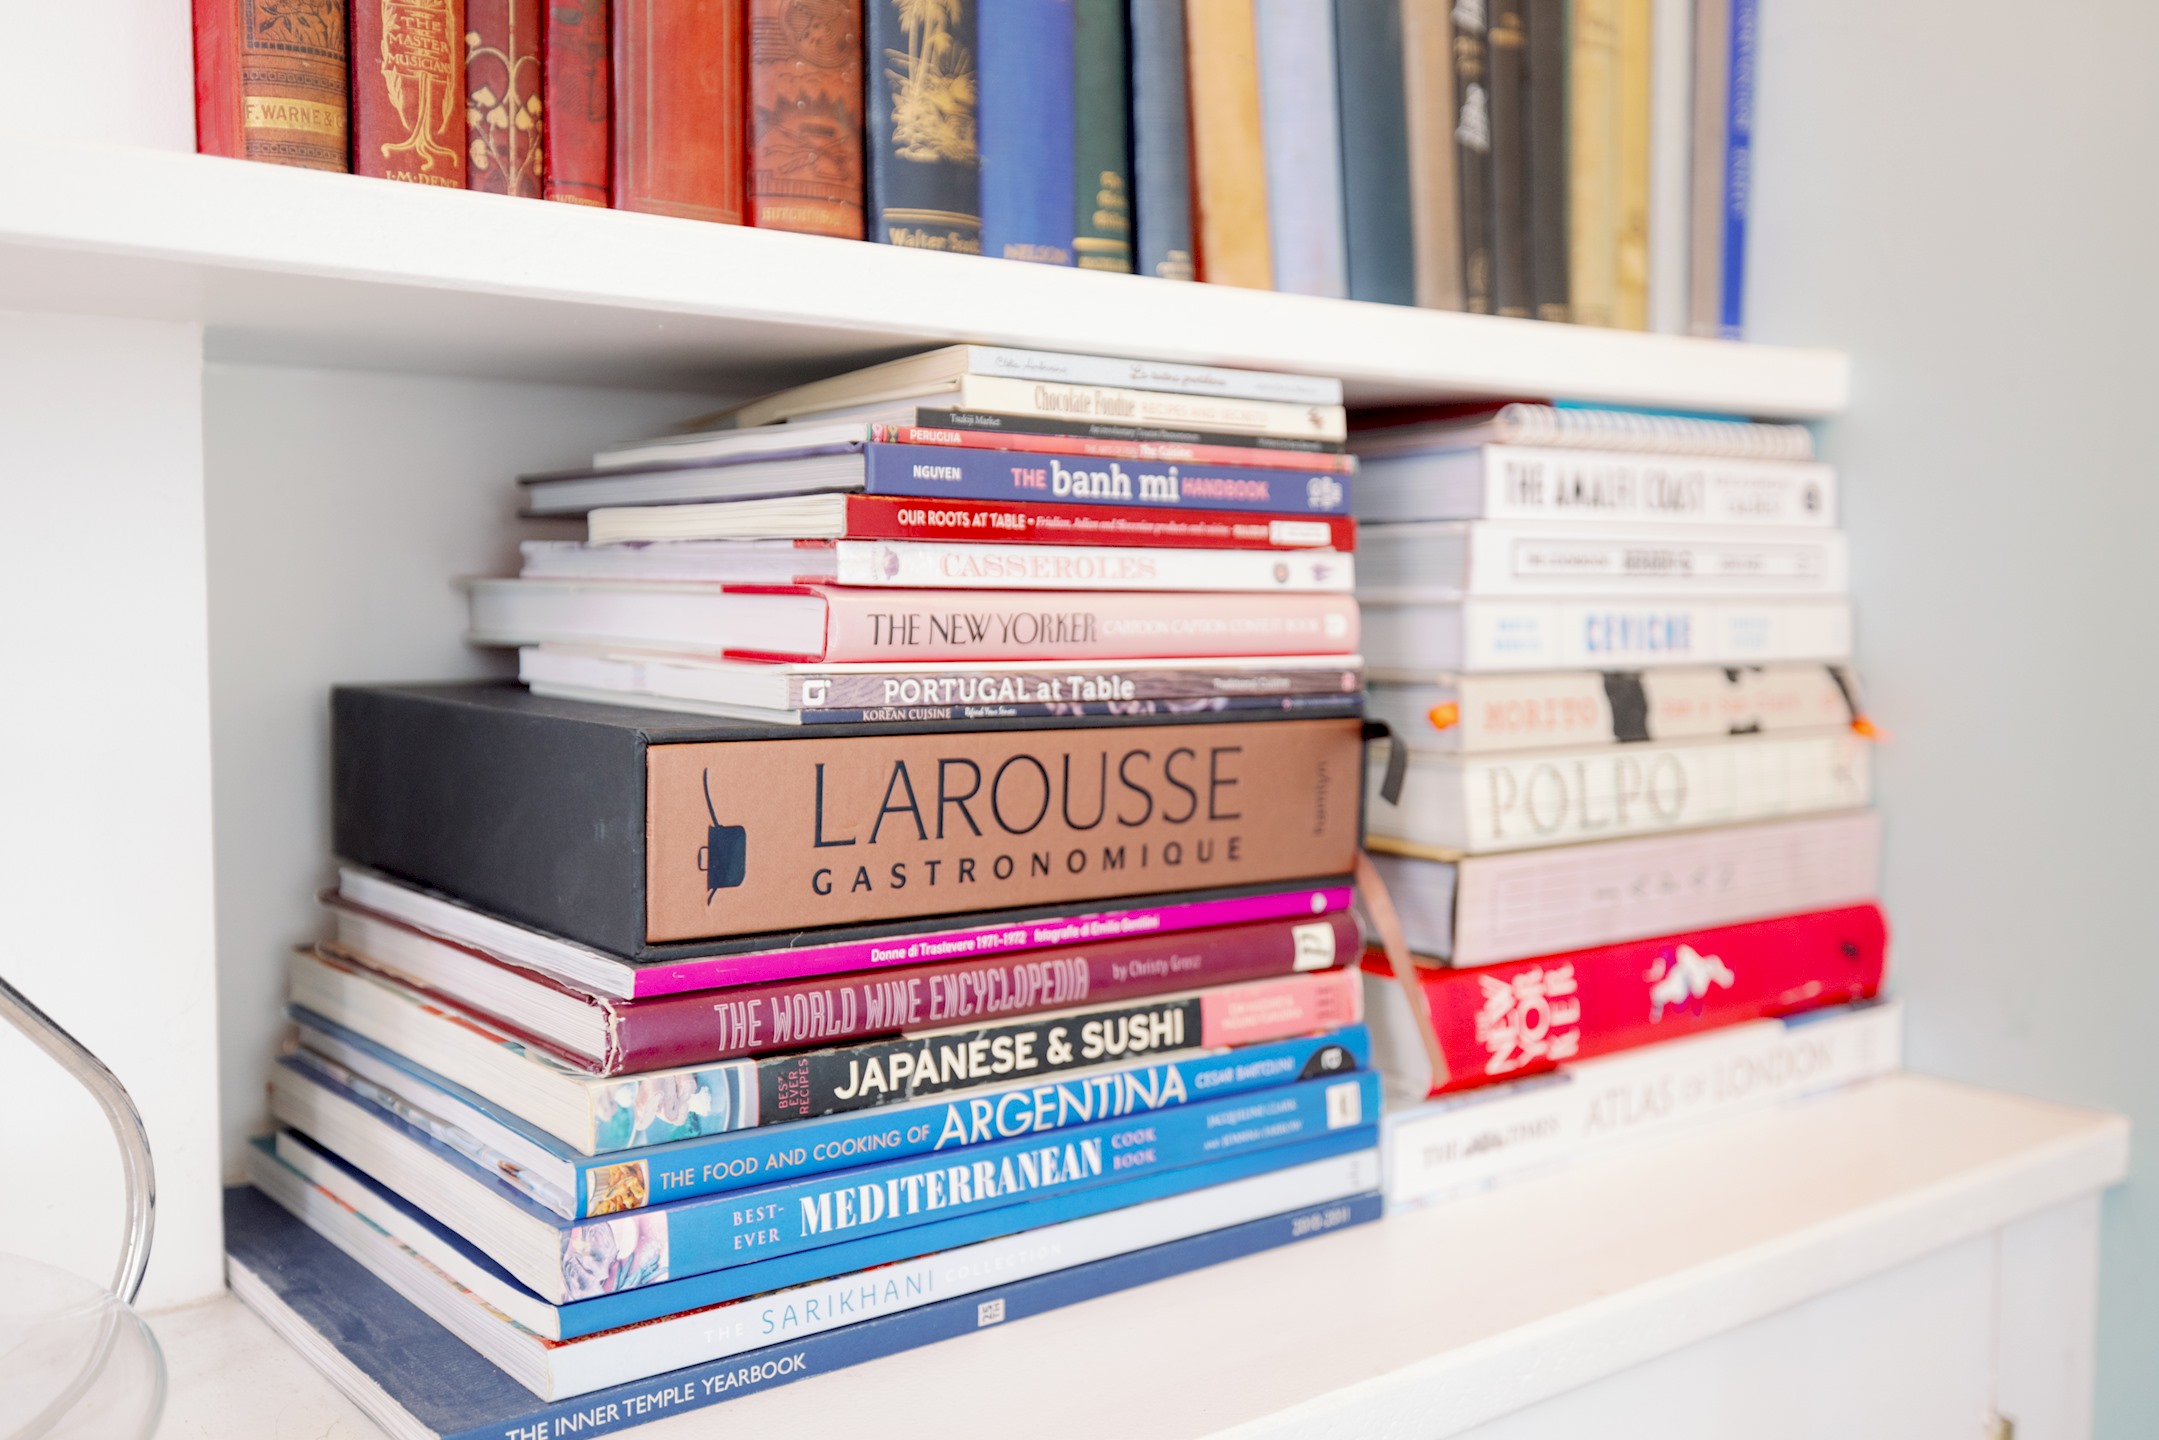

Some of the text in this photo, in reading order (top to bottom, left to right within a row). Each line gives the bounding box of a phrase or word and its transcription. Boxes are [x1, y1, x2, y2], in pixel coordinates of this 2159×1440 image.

[387, 32, 450, 53] MASTER
[401, 16, 441, 31] THE
[387, 53, 452, 73] MUSICIANS
[888, 227, 947, 250] Walter
[950, 413, 1001, 427] Tsukiji Market
[1034, 385, 1092, 414] Chocolate
[1094, 391, 1135, 417] Fondue
[913, 460, 1271, 502] NGUYEN THE banh mi HANDBOOK
[1505, 460, 1545, 507] THE
[897, 508, 926, 527] OUR
[927, 510, 970, 528] ROOTS
[972, 511, 989, 528] AT
[989, 512, 1027, 530] TABLE
[938, 552, 1157, 579] CASSEROLES
[866, 613, 920, 646] THE
[928, 613, 992, 646] NEW
[996, 612, 1096, 645] YORKER
[883, 676, 1031, 704] PORTUGAL
[1037, 680, 1062, 701] at
[1066, 675, 1135, 702] Table
[863, 708, 902, 722] KOREAN
[904, 707, 951, 721] CUISINE
[1481, 696, 1599, 732] MORITO
[812, 746, 1244, 849] LAROUSSE
[1486, 751, 1690, 840] POLPO
[811, 835, 1243, 896] GASTRONOMIQUE
[871, 947, 906, 963] Donne
[907, 943, 919, 958] di
[920, 940, 975, 957] Trastevere
[976, 930, 1027, 950] 1971-1972
[1033, 925, 1079, 944] fotografie
[714, 999, 762, 1051] THE
[771, 987, 857, 1043] WORLD
[863, 978, 921, 1030] WINE
[929, 956, 1091, 1021] ENCYCLOPEDIA
[1112, 962, 1128, 982] by
[833, 1038, 1040, 1101] JAPANESE
[1046, 1031, 1074, 1063] &
[1081, 1007, 1185, 1060] SUSHI
[789, 1070, 800, 1107] EVER
[799, 1058, 811, 1115] RECIPES
[1584, 1072, 1675, 1137] ATLAS
[1713, 1038, 1836, 1102] LONDON
[660, 1168, 695, 1191] THE
[703, 1157, 759, 1183] FOOD
[764, 1148, 807, 1171] AND
[813, 1130, 901, 1162] COOKING
[907, 1124, 931, 1144] OF
[934, 1063, 1188, 1152] ARGENTINA
[733, 1203, 785, 1227] BEST-
[800, 1137, 1102, 1238] MEDITERRANEAN
[1111, 1127, 1158, 1150] COOK
[733, 1228, 781, 1251] EVER
[1113, 1148, 1158, 1171] BOOK
[704, 1242, 1063, 1343] THE SARIKHANI COLLECTION
[554, 1403, 620, 1438] INNER
[622, 1382, 696, 1418] TEMPLE
[701, 1352, 807, 1396] YEARBOOK
